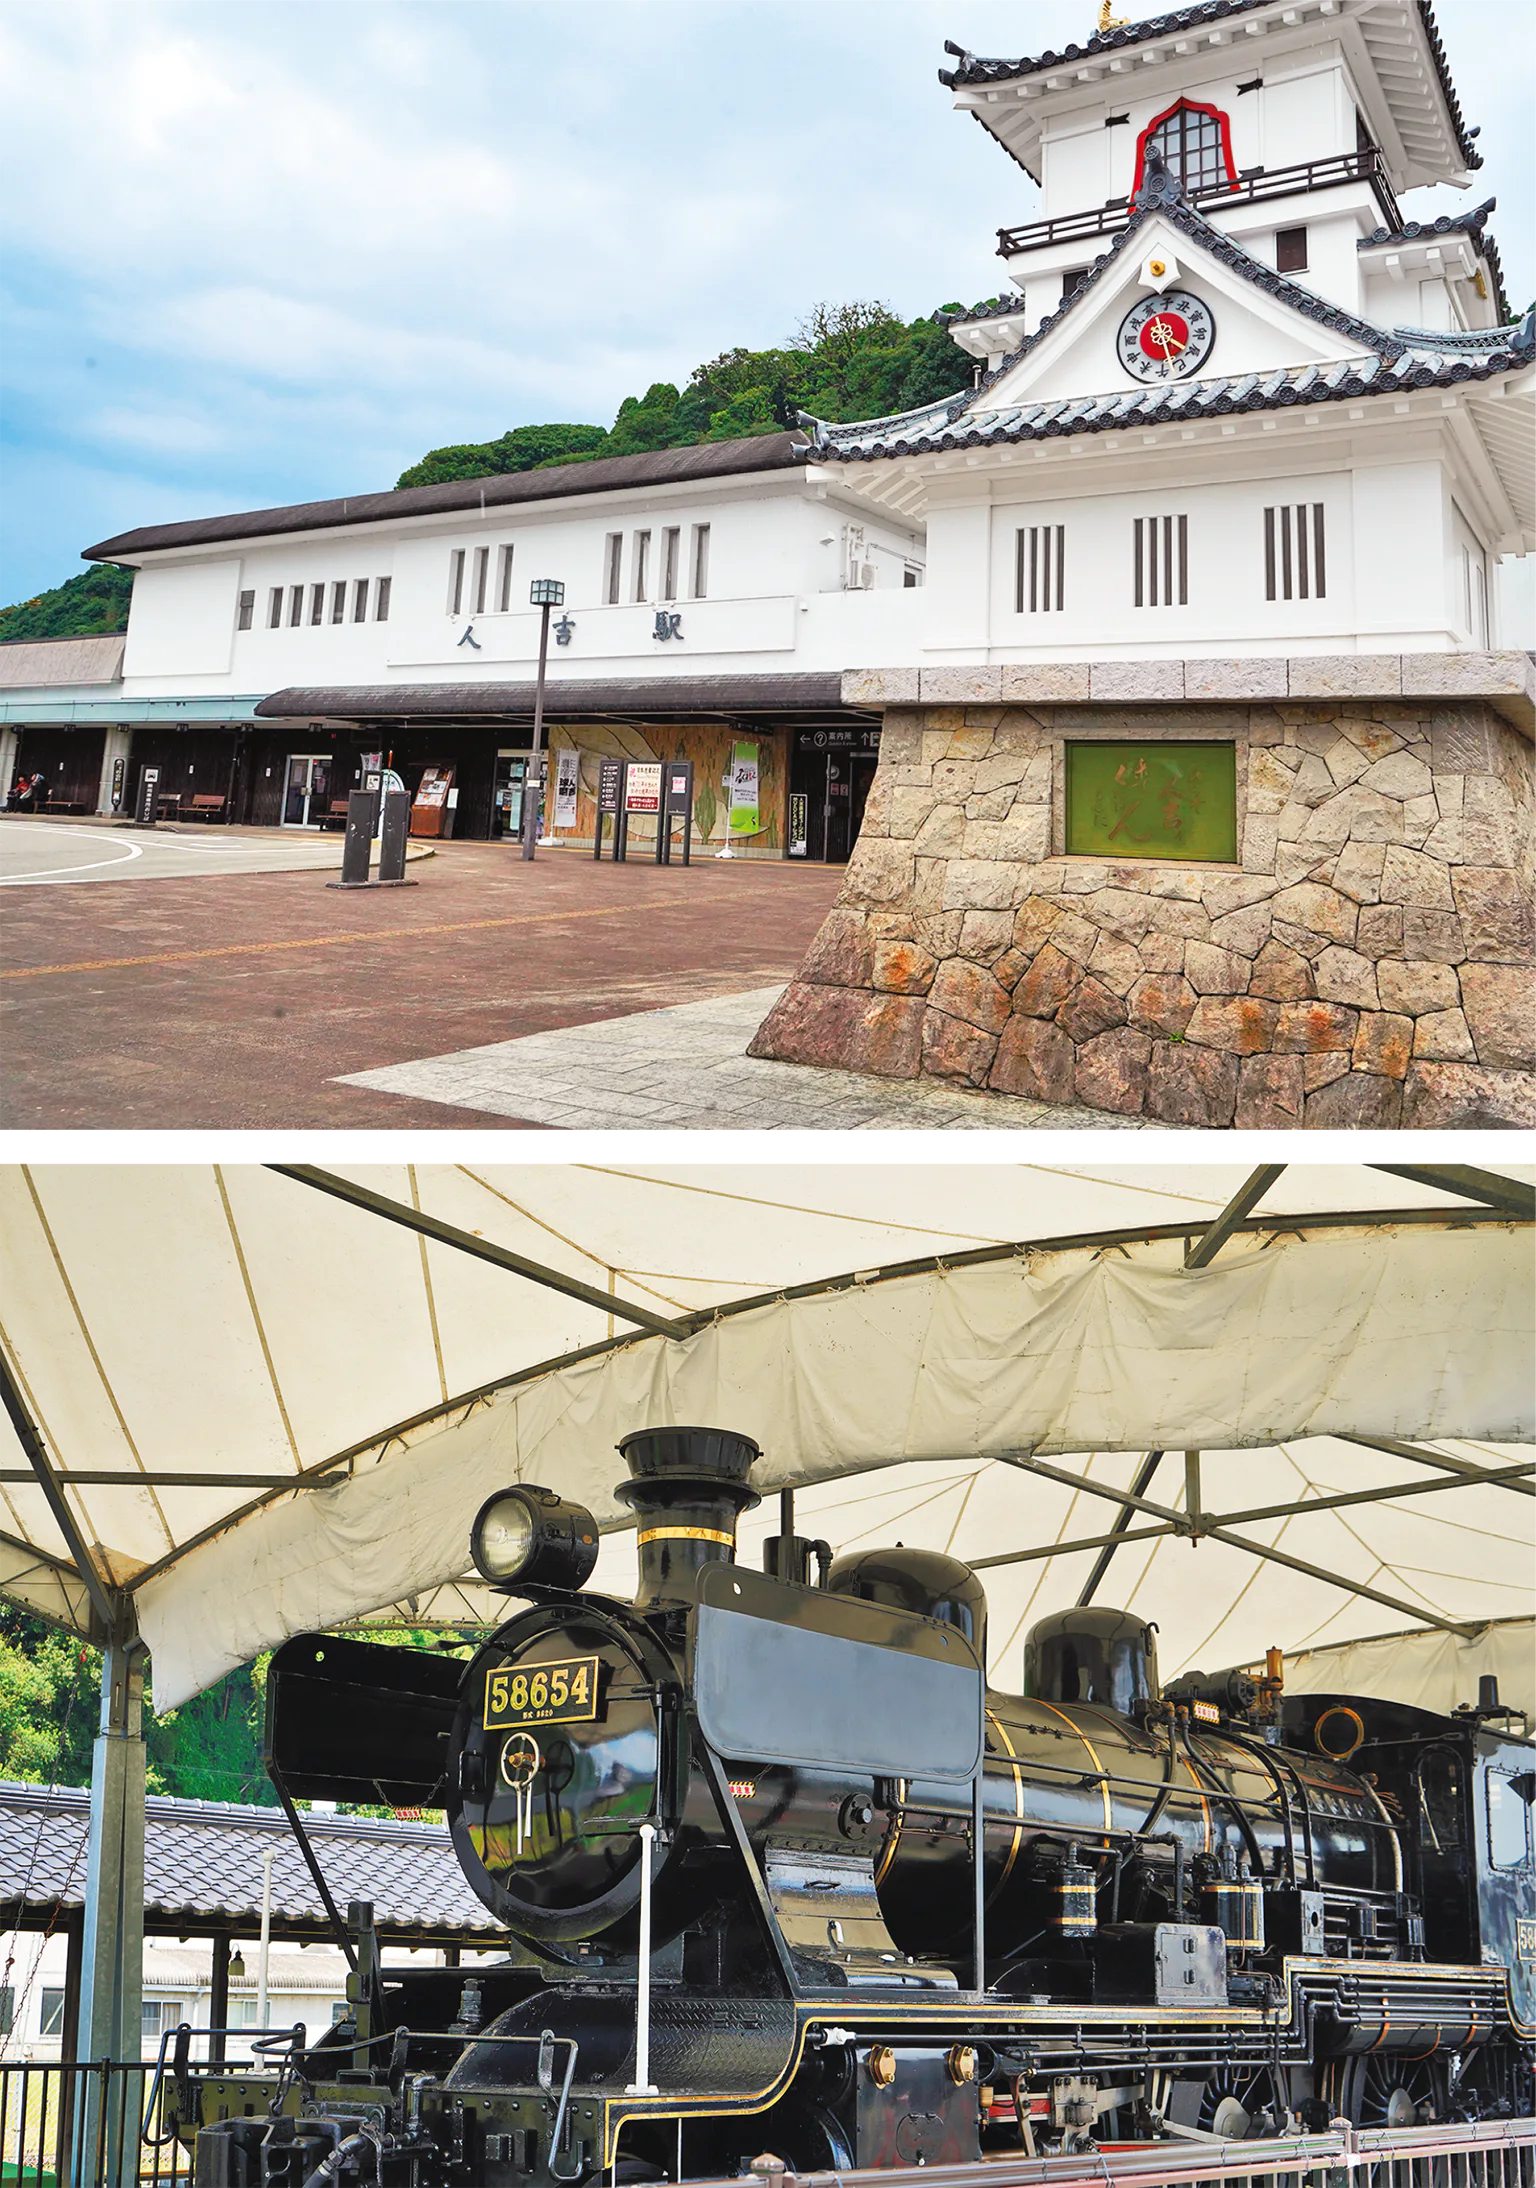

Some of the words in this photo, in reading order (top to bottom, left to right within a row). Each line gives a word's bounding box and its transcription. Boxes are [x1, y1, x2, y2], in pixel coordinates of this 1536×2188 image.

[1159, 297, 1174, 311] 子
[1176, 300, 1190, 313] 丑
[828, 731, 852, 741] 案内所
[491, 1666, 589, 1713] 58654
[1520, 1926, 1536, 1949] 58
